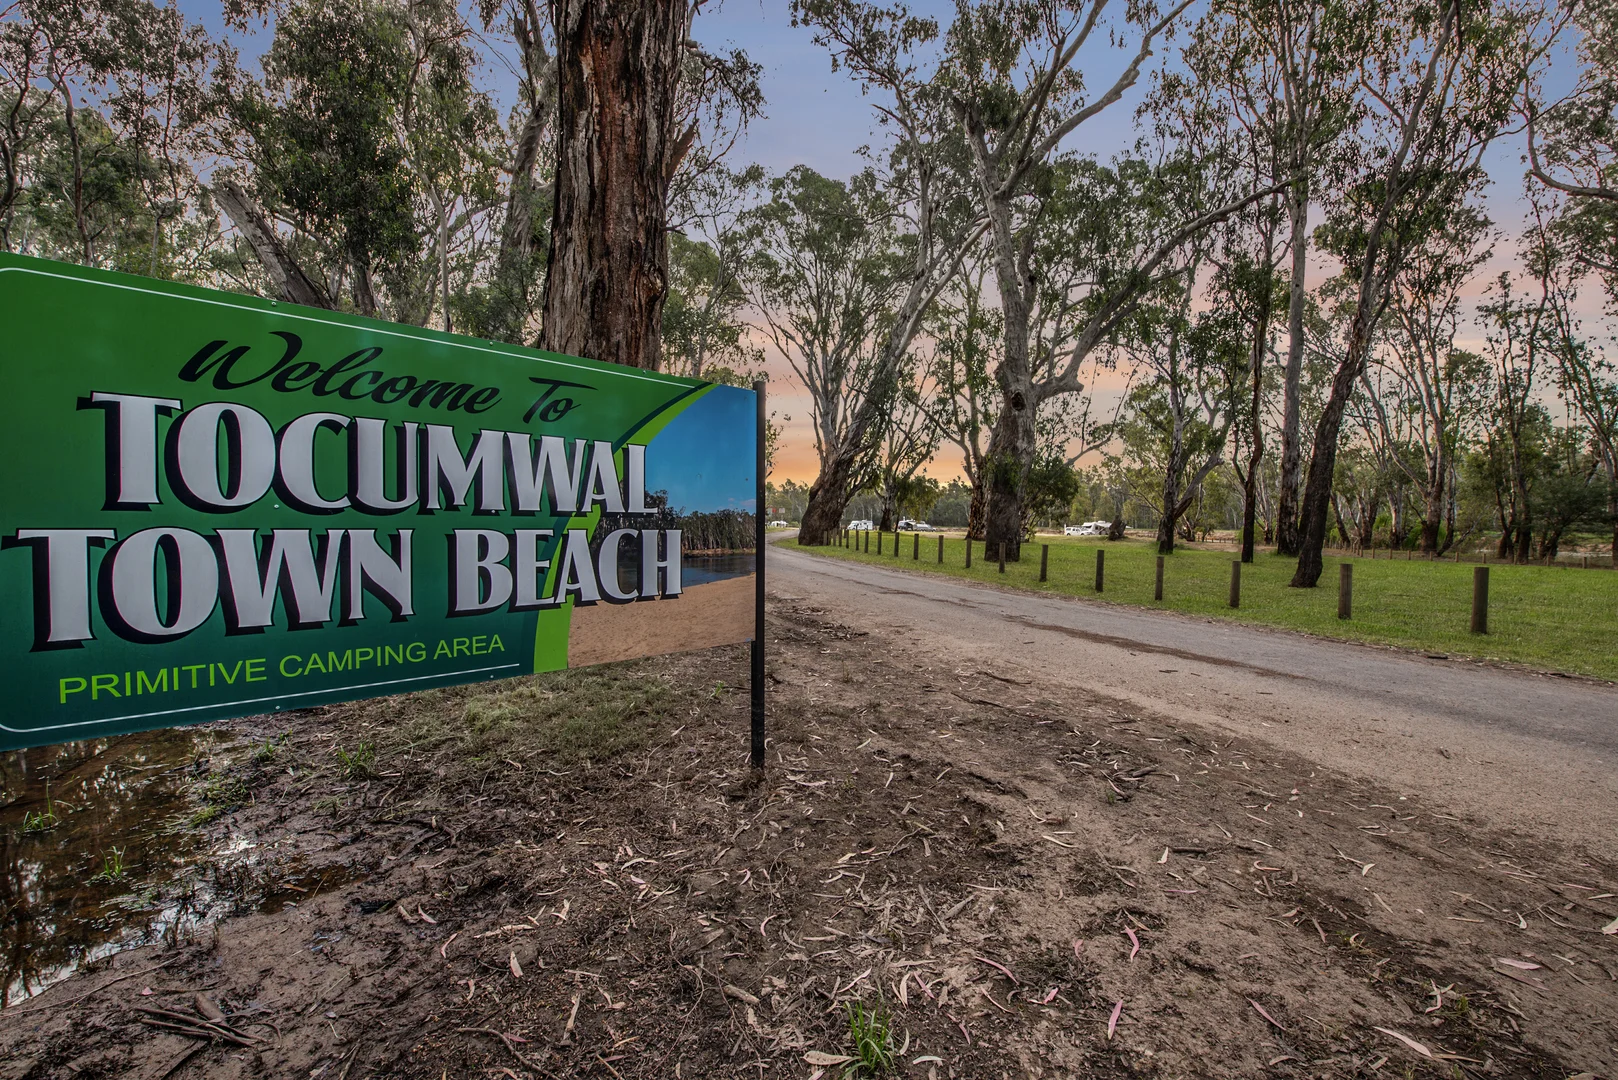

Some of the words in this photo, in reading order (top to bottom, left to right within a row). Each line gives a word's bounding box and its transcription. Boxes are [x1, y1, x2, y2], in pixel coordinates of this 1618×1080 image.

[178, 331, 502, 413] Welcome
[522, 377, 598, 423] To
[77, 390, 658, 516] TOCUMWAL
[2, 526, 415, 652] TOWN
[446, 528, 684, 618] BEACH
[59, 658, 267, 703] PRIMITIVE
[279, 641, 427, 677] CAMPING
[433, 634, 505, 660] AREA
